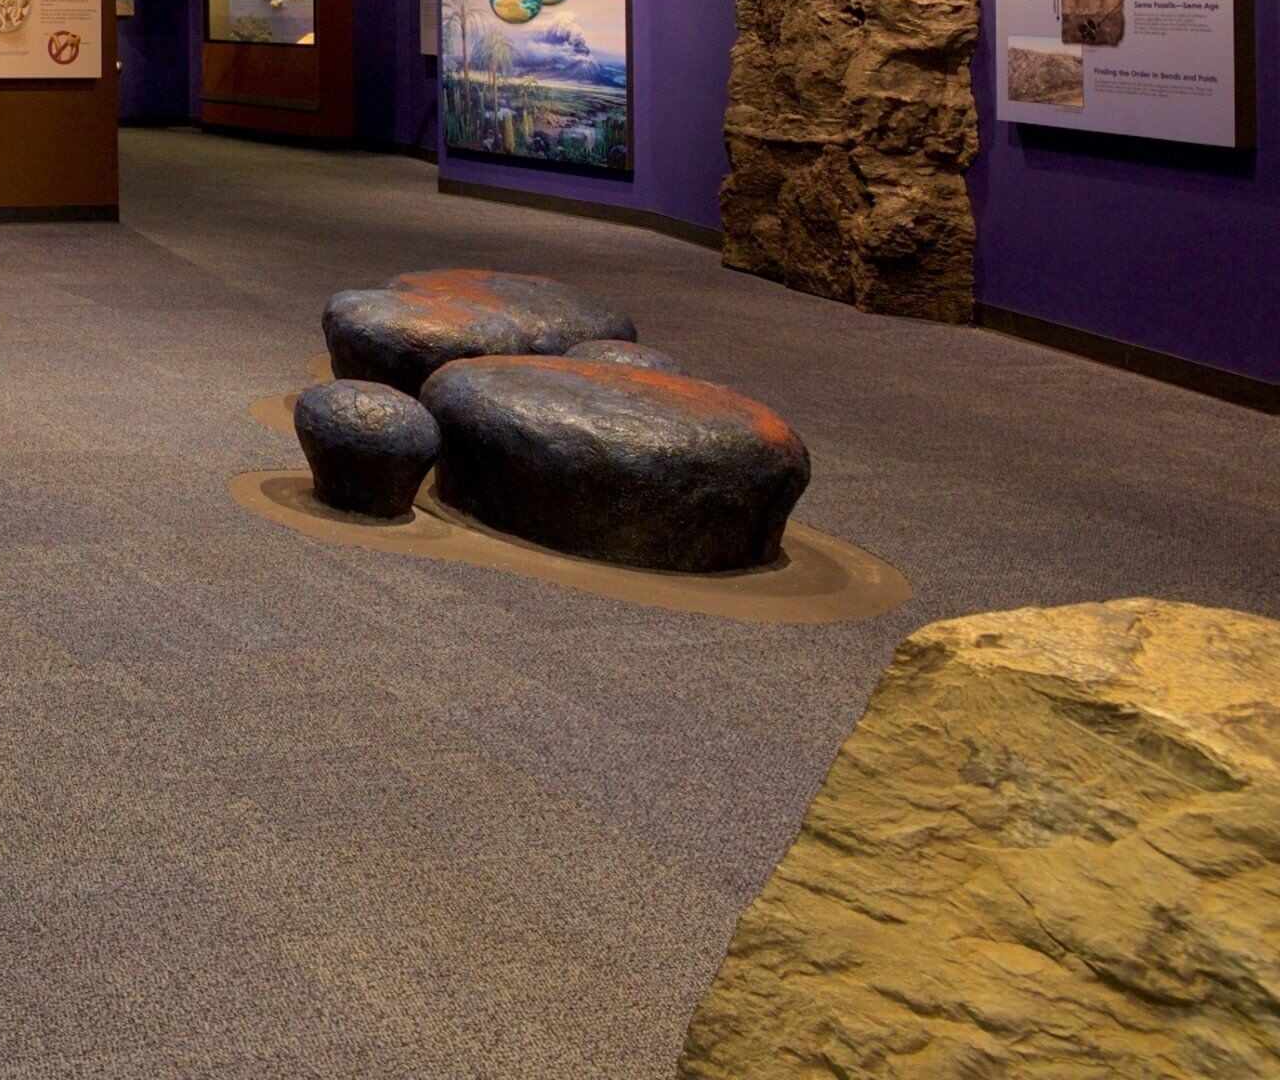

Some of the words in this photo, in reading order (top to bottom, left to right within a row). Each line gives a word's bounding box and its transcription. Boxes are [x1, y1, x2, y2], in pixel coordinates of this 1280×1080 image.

[1205, 2, 1219, 11] Age
[1094, 67, 1117, 77] Finding
[1118, 69, 1130, 77] the
[1131, 70, 1151, 78] Order
